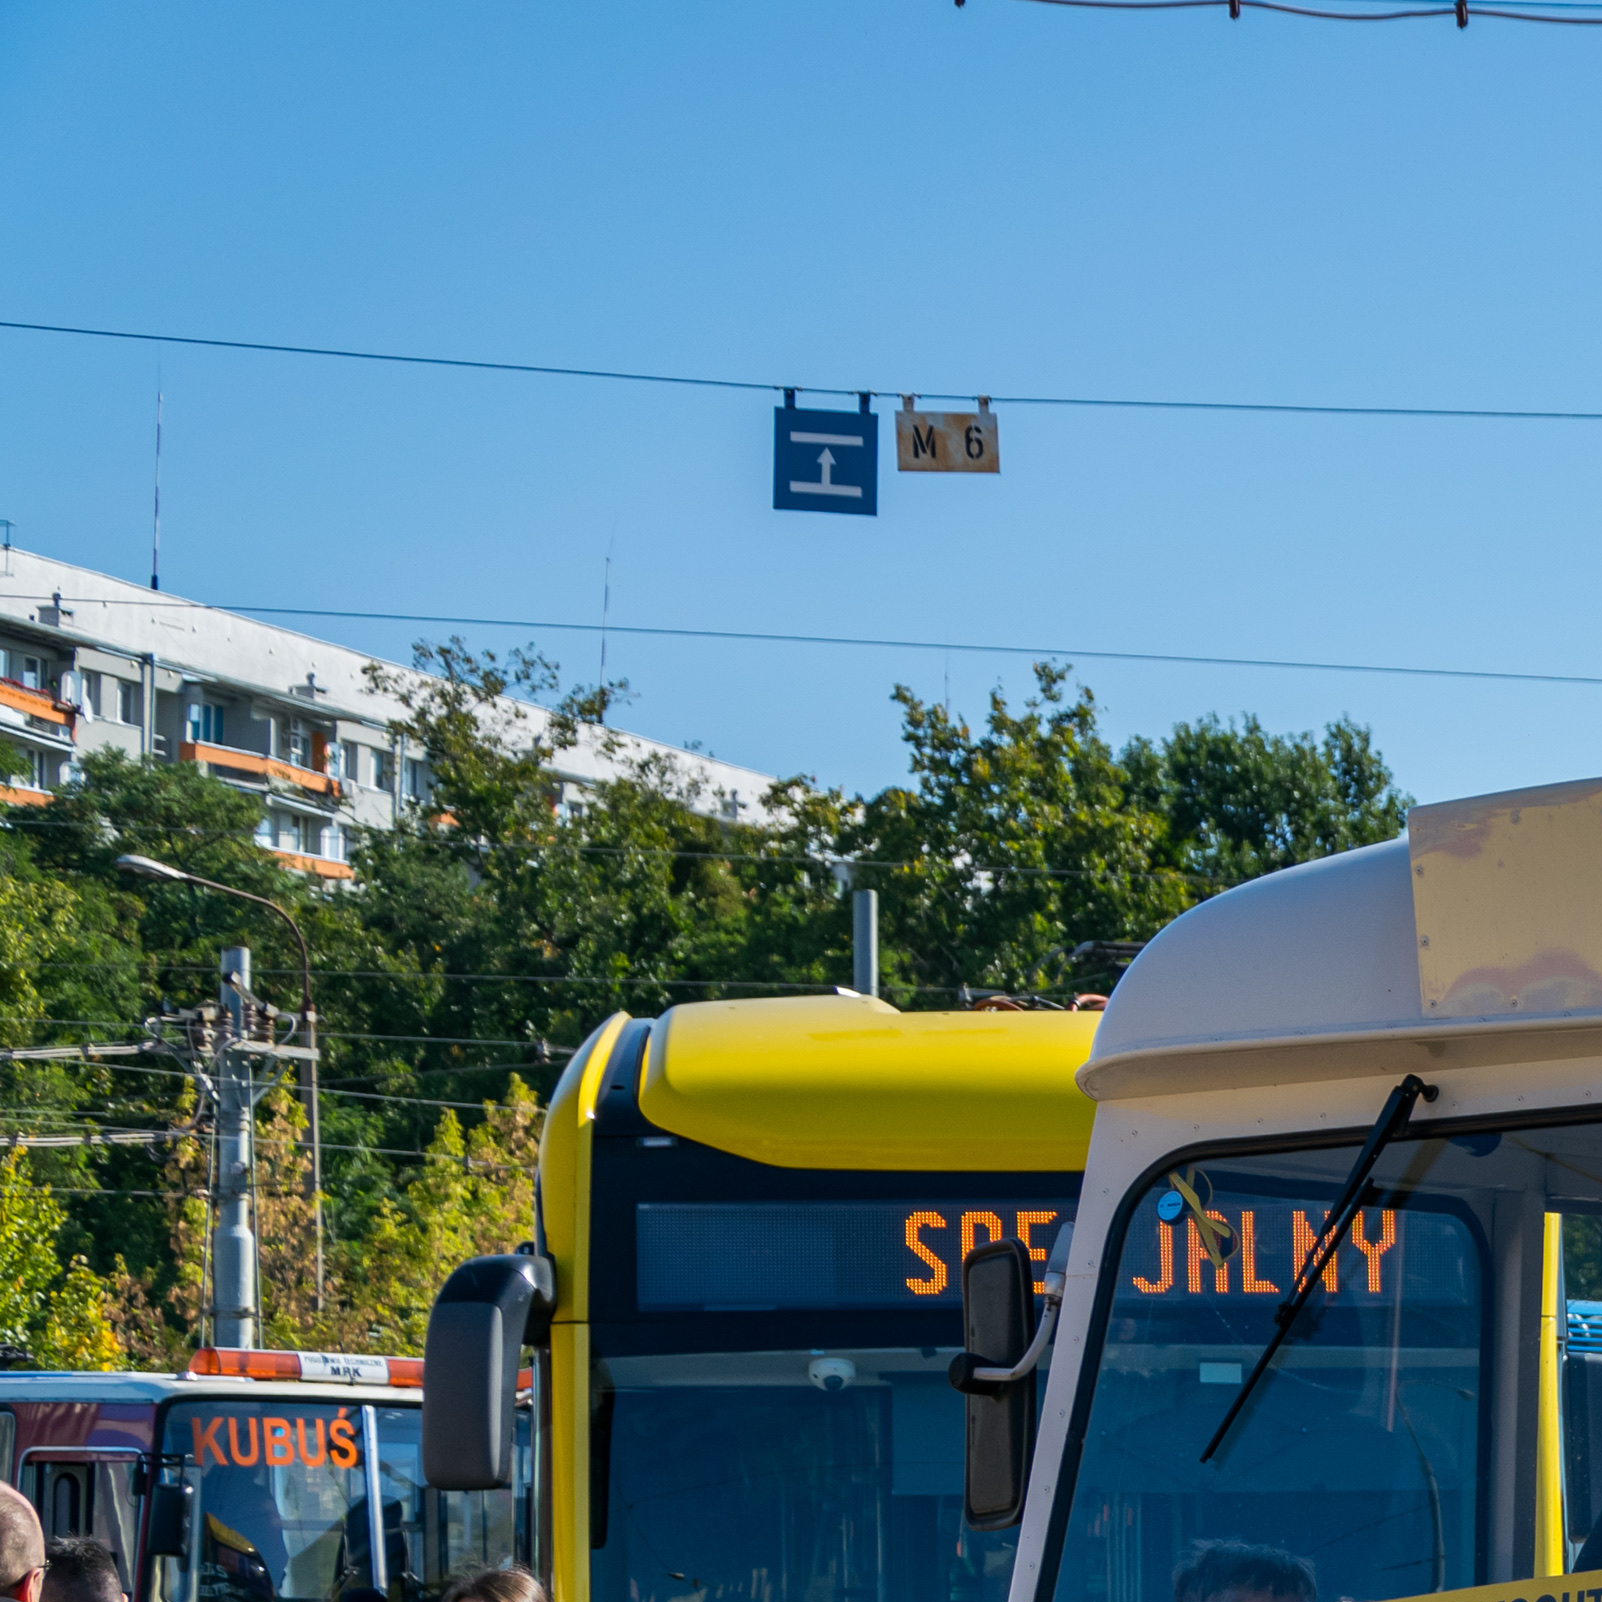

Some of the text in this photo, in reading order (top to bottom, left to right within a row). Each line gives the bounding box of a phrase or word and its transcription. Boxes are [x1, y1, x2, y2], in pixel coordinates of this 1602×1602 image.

[912, 425, 985, 459] M 6
[904, 1210, 1396, 1296] SPEJALNY
[330, 1366, 362, 1377] MPK
[191, 1407, 358, 1468] KUBUŚ
